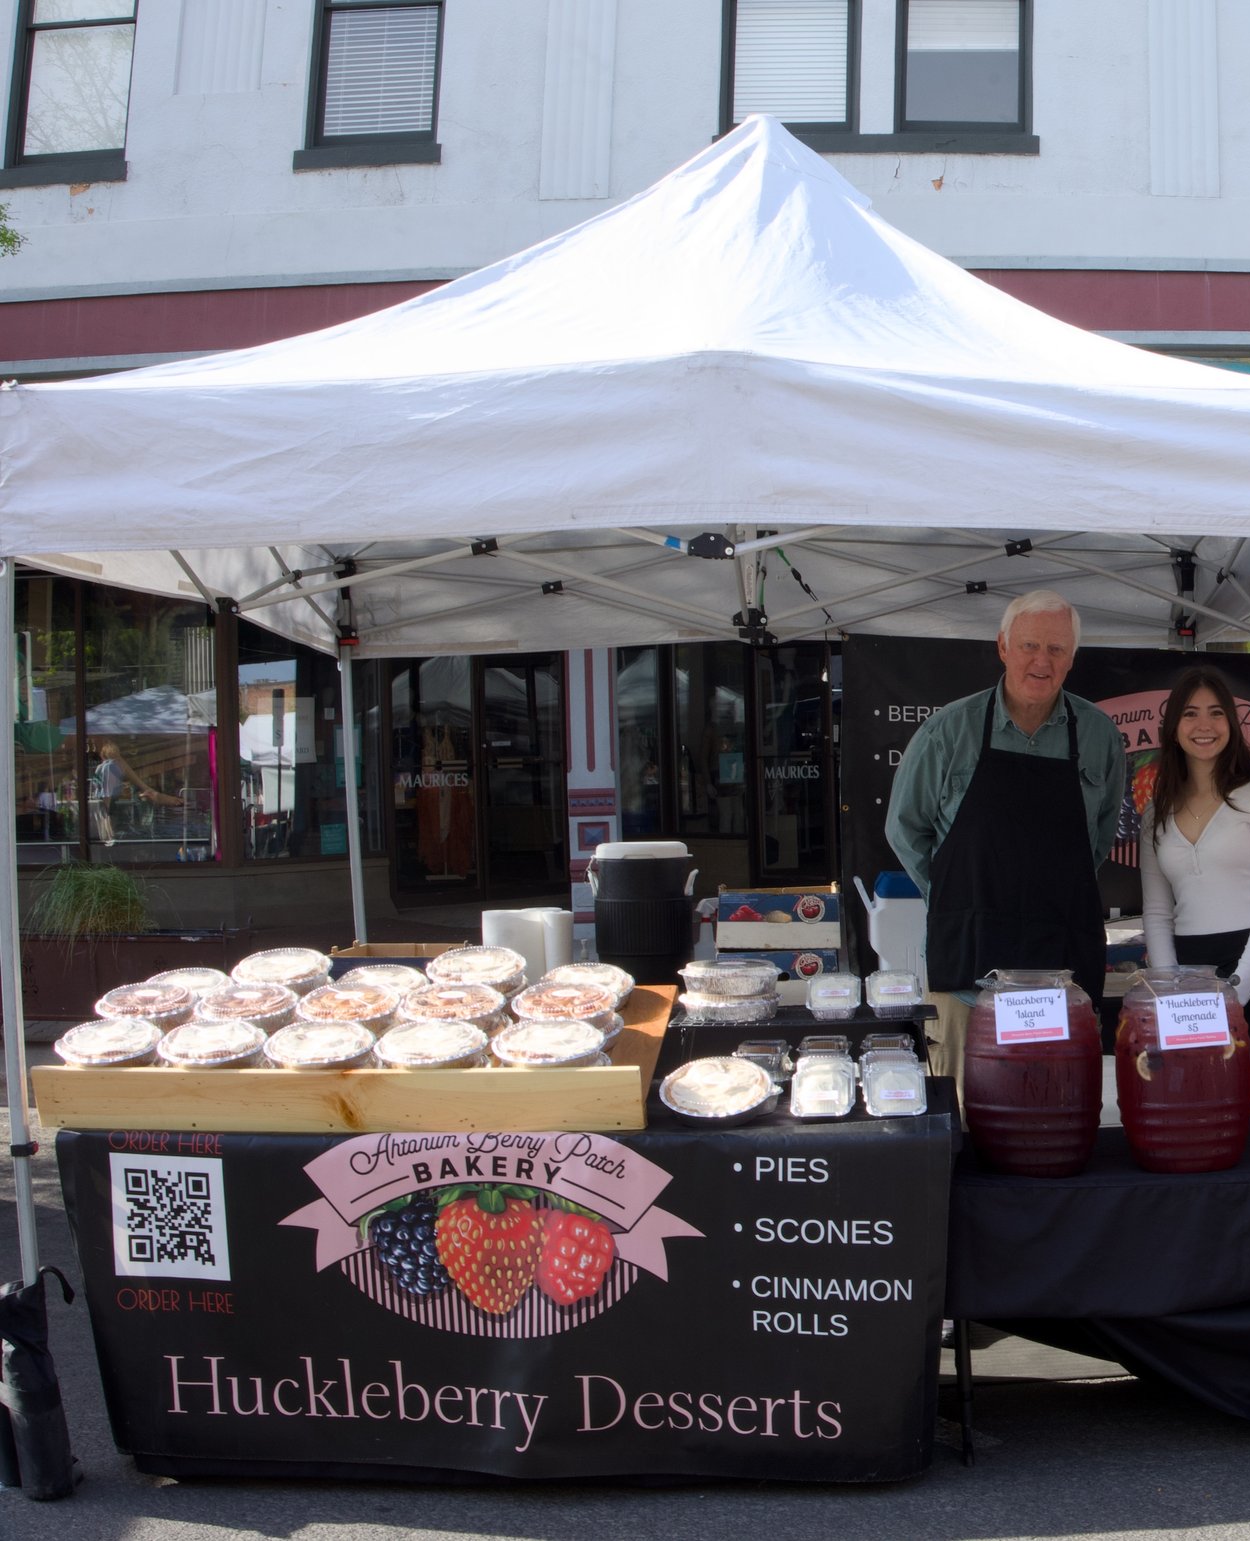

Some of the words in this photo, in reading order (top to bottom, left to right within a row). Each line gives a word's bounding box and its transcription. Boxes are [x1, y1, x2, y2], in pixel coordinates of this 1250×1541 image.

[400, 773, 469, 788] MAURICES
[764, 765, 820, 779] MAURICES
[1005, 996, 1054, 1006] Blackberry
[1015, 1008, 1045, 1019] Island
[1165, 998, 1220, 1008] Huckleberry
[1024, 1019, 1035, 1028] $5
[1171, 1011, 1217, 1024] Lemonade
[1188, 1023, 1199, 1032] $5
[108, 1130, 169, 1152] ORDER
[178, 1133, 224, 1155] HERE
[350, 1133, 460, 1176] Ahtanum
[466, 1132, 546, 1158] Berry
[548, 1133, 627, 1179] Patch
[412, 1155, 562, 1185] BAKERY
[755, 1156, 830, 1183] PIES
[755, 1217, 894, 1245] SCONES
[750, 1275, 914, 1301] CINNAMON
[117, 1288, 180, 1311] ORDER
[189, 1291, 235, 1314] HERE
[752, 1310, 849, 1337] ROLLS
[164, 1355, 549, 1453] Huckleberry
[574, 1375, 843, 1440] Desserts
